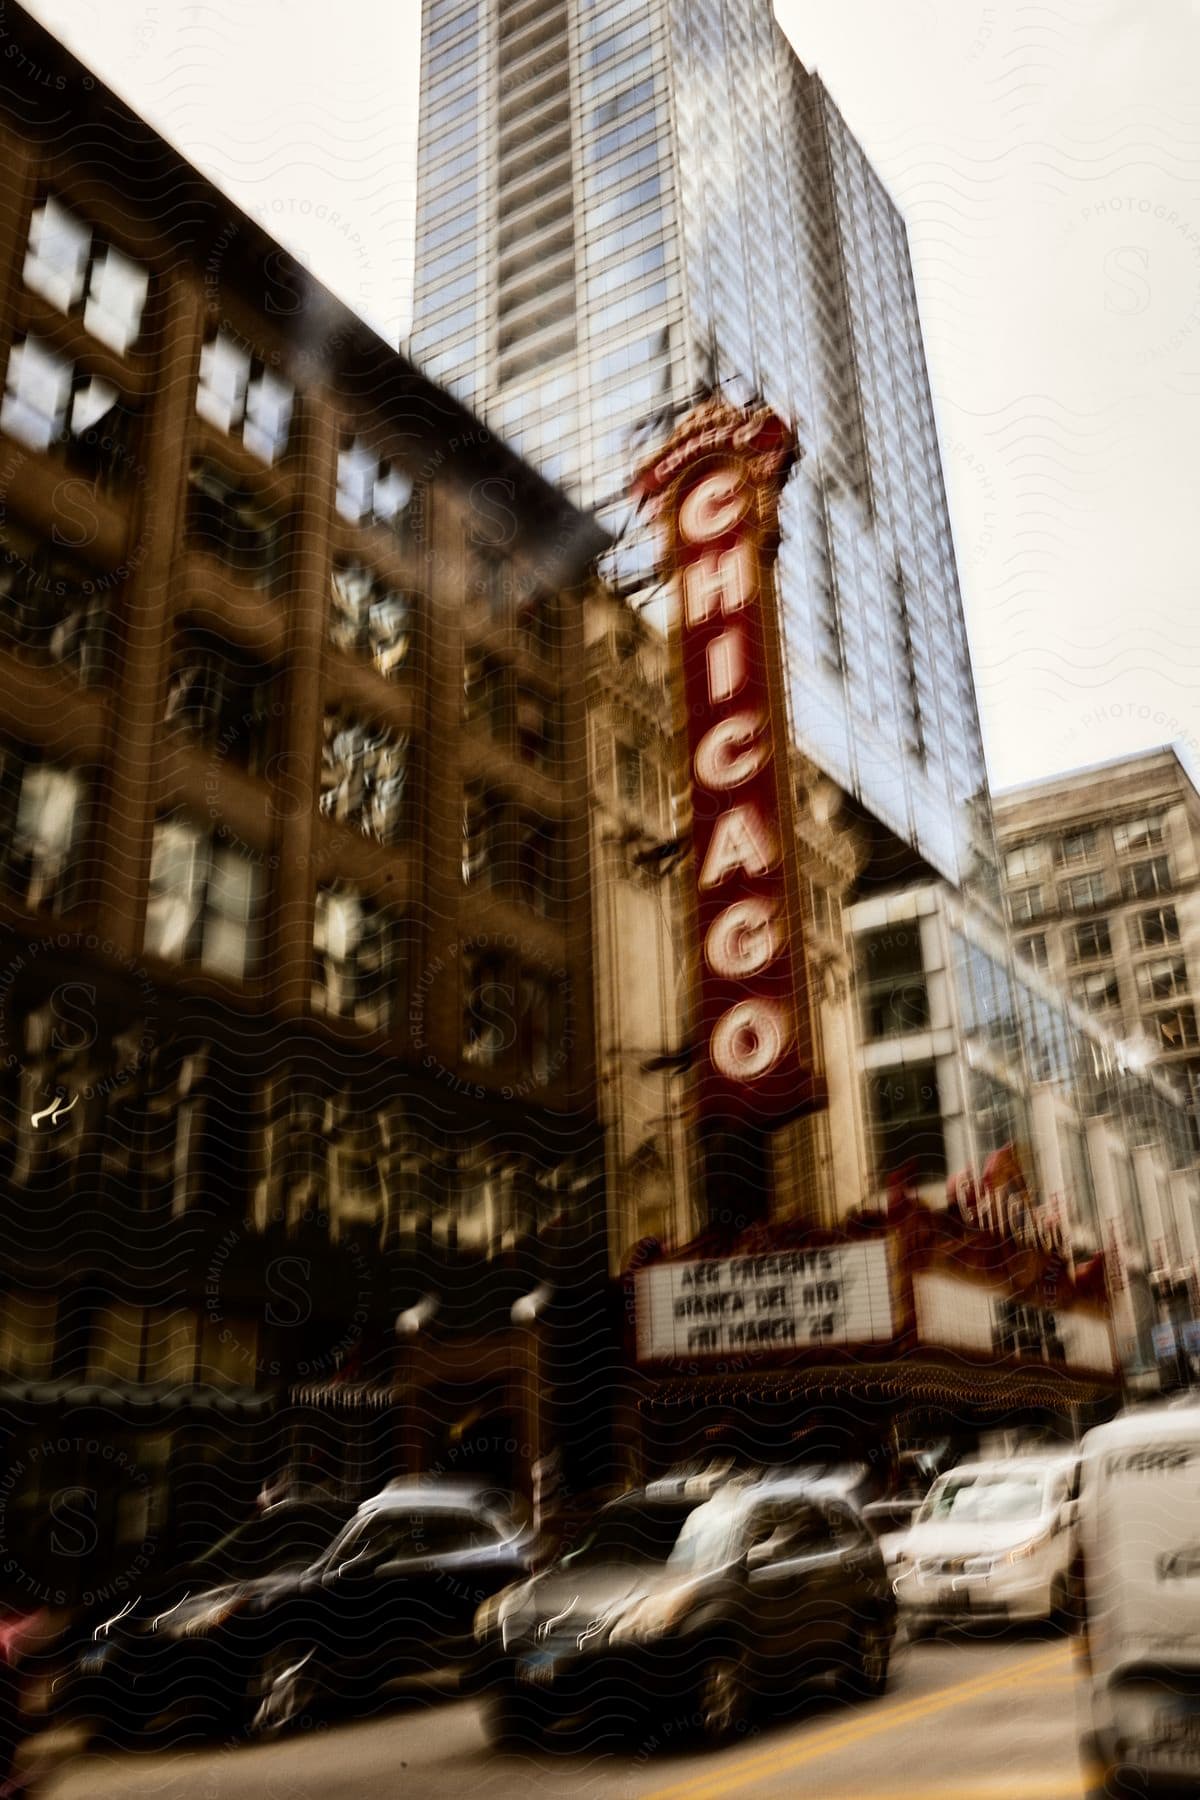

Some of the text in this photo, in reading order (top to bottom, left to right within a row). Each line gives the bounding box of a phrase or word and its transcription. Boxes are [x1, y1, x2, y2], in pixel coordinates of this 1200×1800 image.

[679, 464, 795, 1082] CHICAGO
[681, 1249, 832, 1290] AEG PRESENTS
[755, 1285, 787, 1312] DEL
[802, 1280, 839, 1306] RIO
[728, 1317, 796, 1344] MARCH
